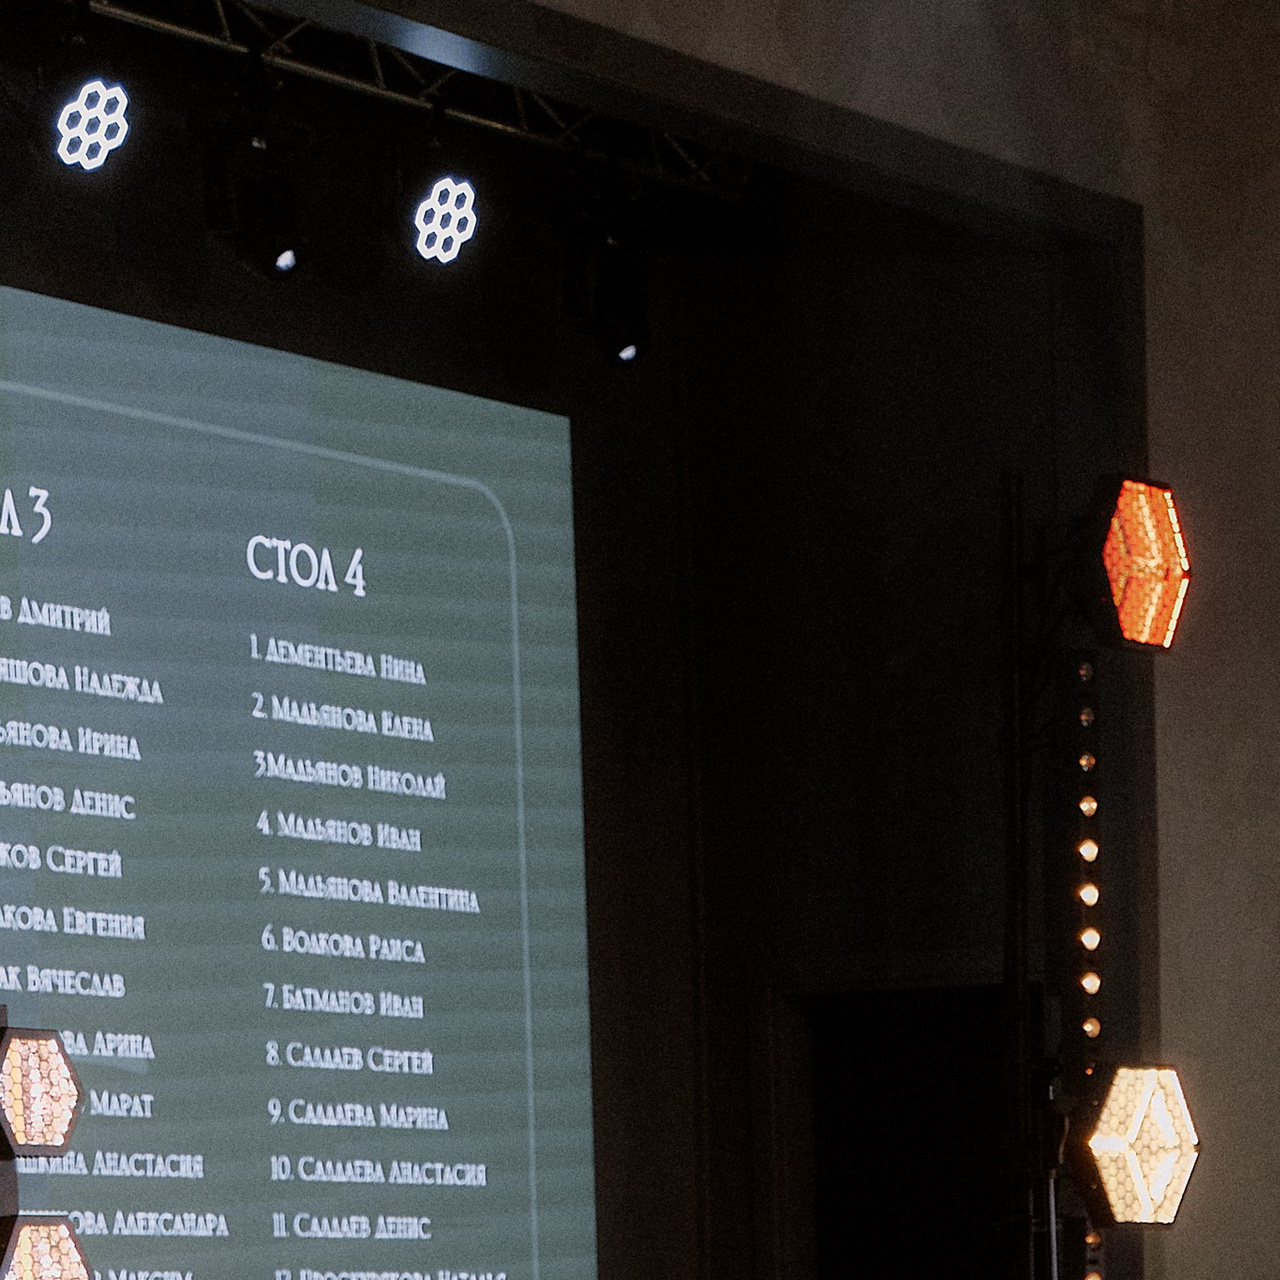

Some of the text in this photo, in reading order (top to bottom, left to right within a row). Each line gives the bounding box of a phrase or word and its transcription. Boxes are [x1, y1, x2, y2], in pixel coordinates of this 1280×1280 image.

[29, 486, 51, 543] 3
[247, 535, 365, 596] СТОЛ 4
